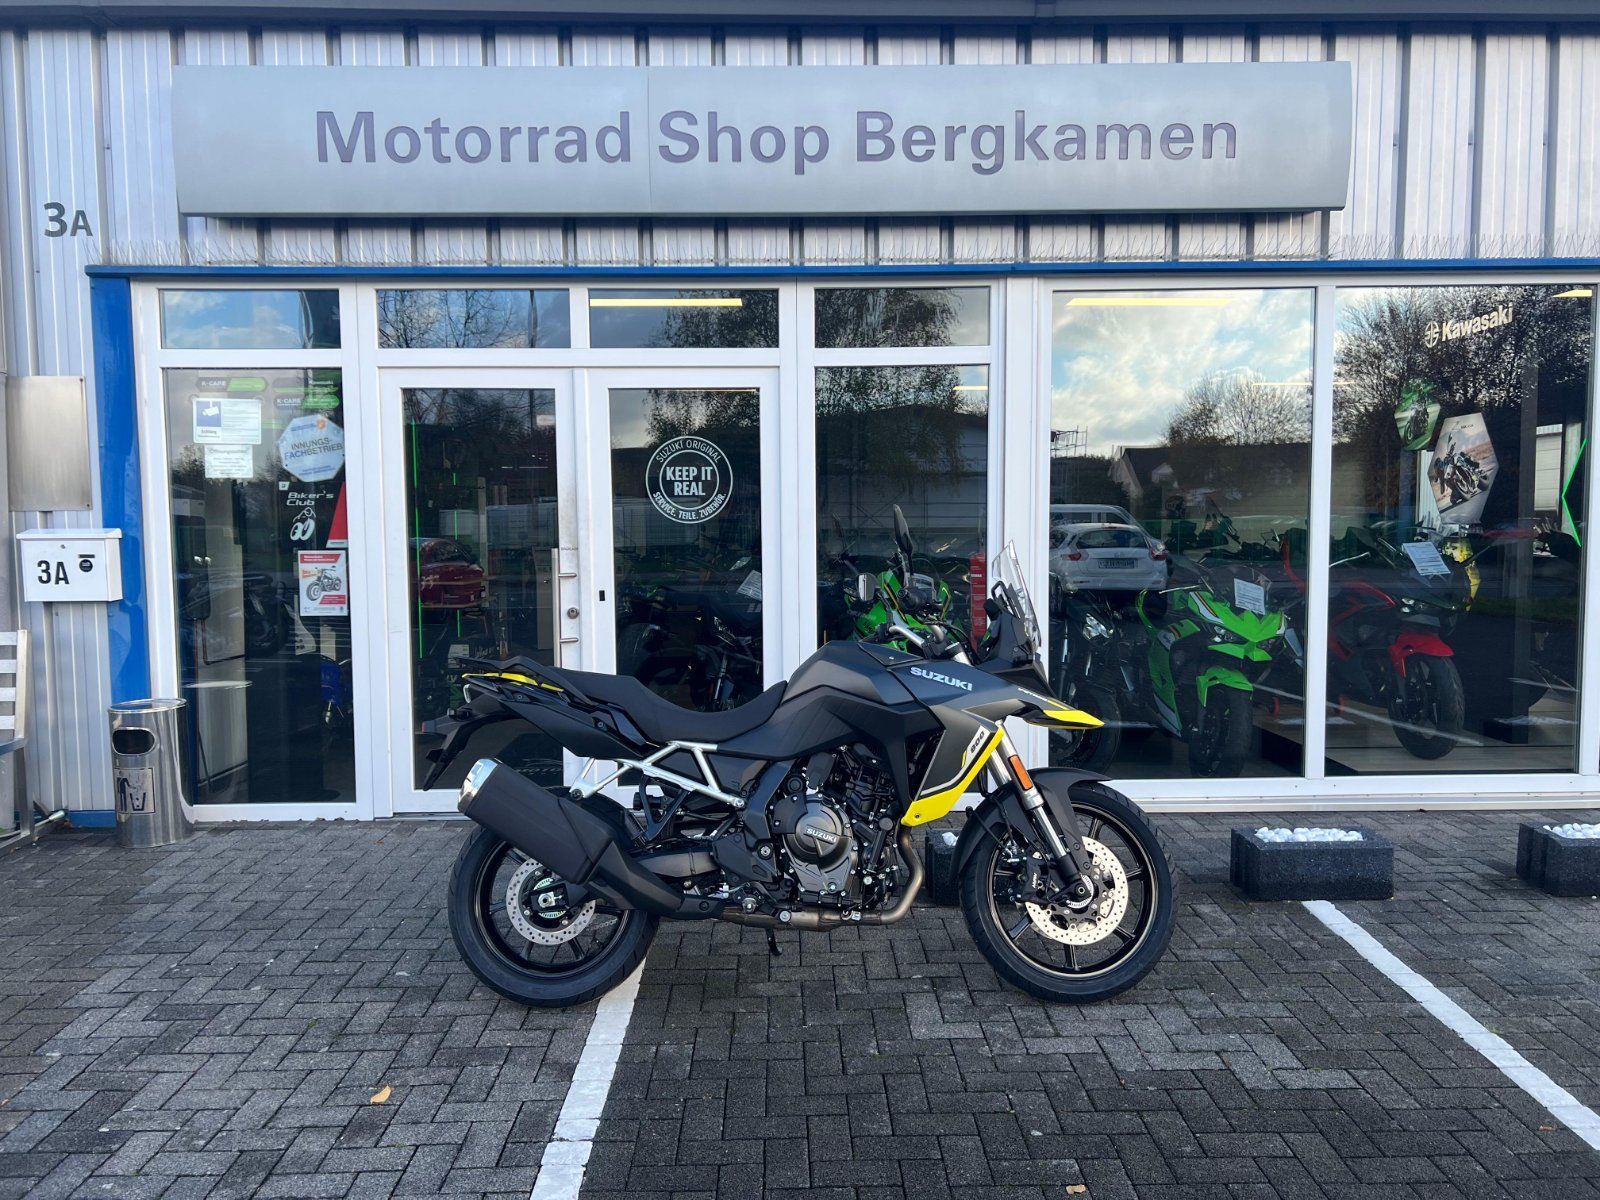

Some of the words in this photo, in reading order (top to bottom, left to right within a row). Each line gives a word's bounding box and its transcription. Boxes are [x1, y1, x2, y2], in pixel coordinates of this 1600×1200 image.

[315, 111, 631, 164] Motorrad
[657, 110, 830, 175] Shop
[855, 109, 1237, 175] Bergkamen
[43, 201, 94, 238] 3A
[1441, 303, 1513, 341] Kawasaki
[284, 443, 344, 460] FACHBETRIEB
[655, 440, 684, 463] SUZUKI
[685, 439, 722, 464] ORIGINAL
[666, 466, 698, 481] KEEP
[701, 466, 713, 481] IT
[287, 490, 334, 499] Biker's
[674, 481, 706, 496] REAL
[286, 498, 315, 506] Club
[652, 491, 677, 517] SERVICE.
[678, 511, 699, 520] TEILE.
[698, 493, 727, 518] ZUBEHÖR.
[37, 560, 70, 585] 3A
[910, 666, 973, 692] SUZUKI
[806, 828, 837, 843] SUZUKI
